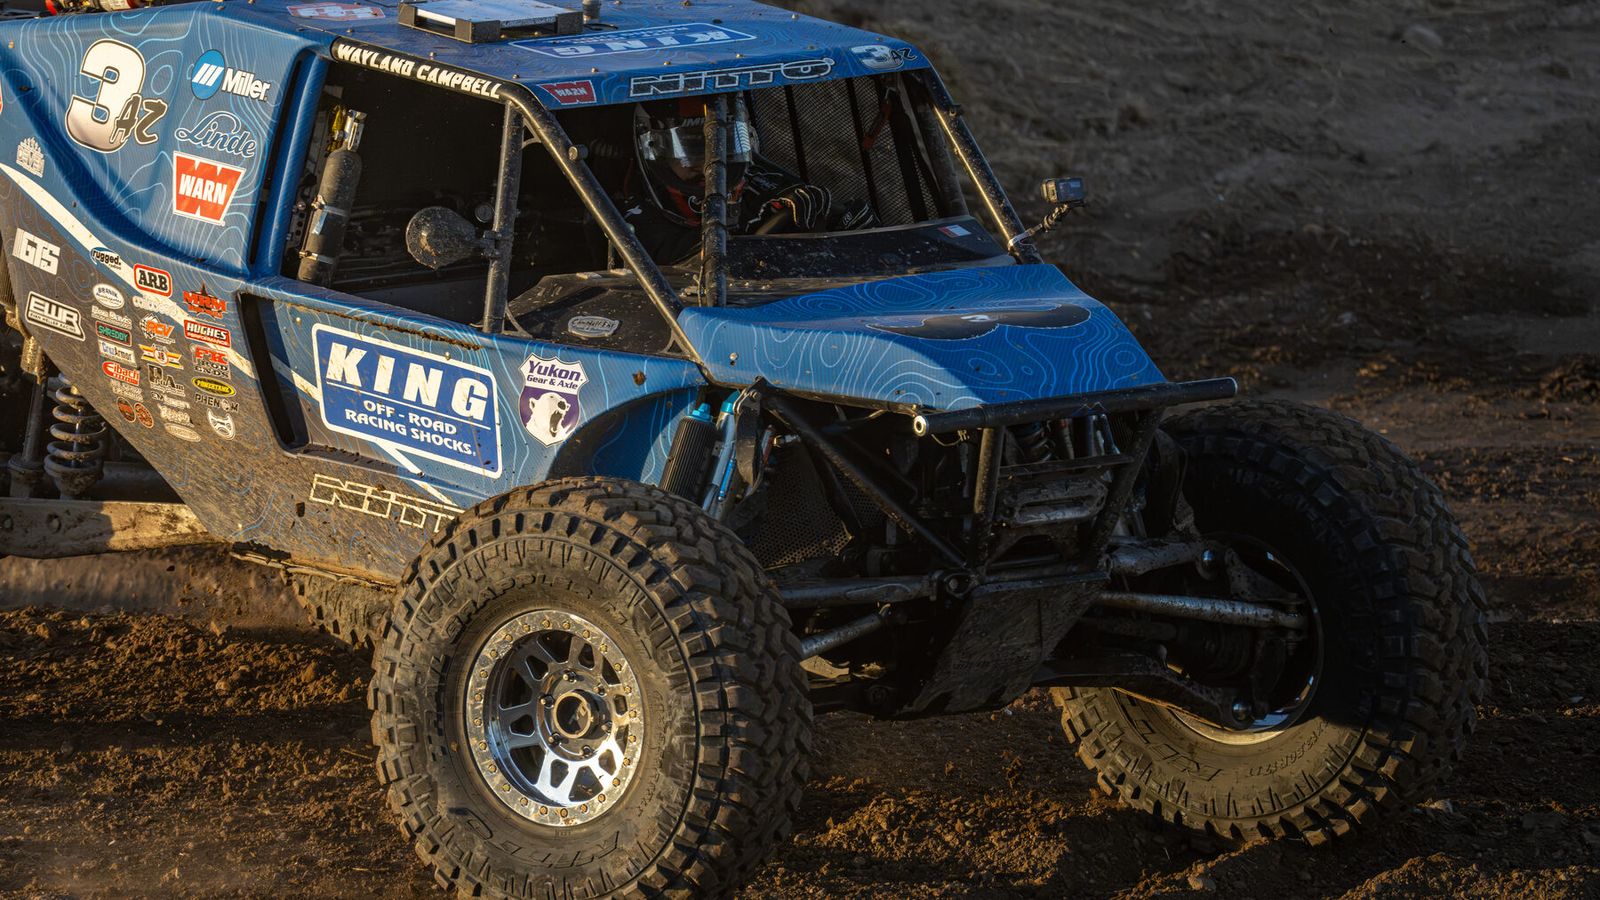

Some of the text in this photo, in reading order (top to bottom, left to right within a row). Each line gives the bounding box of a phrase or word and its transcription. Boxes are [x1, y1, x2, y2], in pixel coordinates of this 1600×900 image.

[553, 31, 731, 55] KING
[850, 45, 904, 70] 3
[221, 67, 271, 100] Miller
[336, 43, 501, 99] WAYLAND CAMPBELL
[630, 57, 835, 97] NITTO
[66, 39, 146, 153] 3
[555, 87, 588, 97] WARN
[174, 110, 257, 158] Linde
[178, 173, 228, 205] WARN
[138, 270, 169, 292] ARB
[187, 322, 227, 340] HUGHES
[325, 342, 490, 421] KING
[526, 374, 548, 385] Gear
[557, 380, 578, 390] Axle
[528, 360, 582, 382] Yukon
[345, 408, 408, 436] RACING
[363, 399, 396, 418] OFF
[408, 412, 457, 435] ROAD
